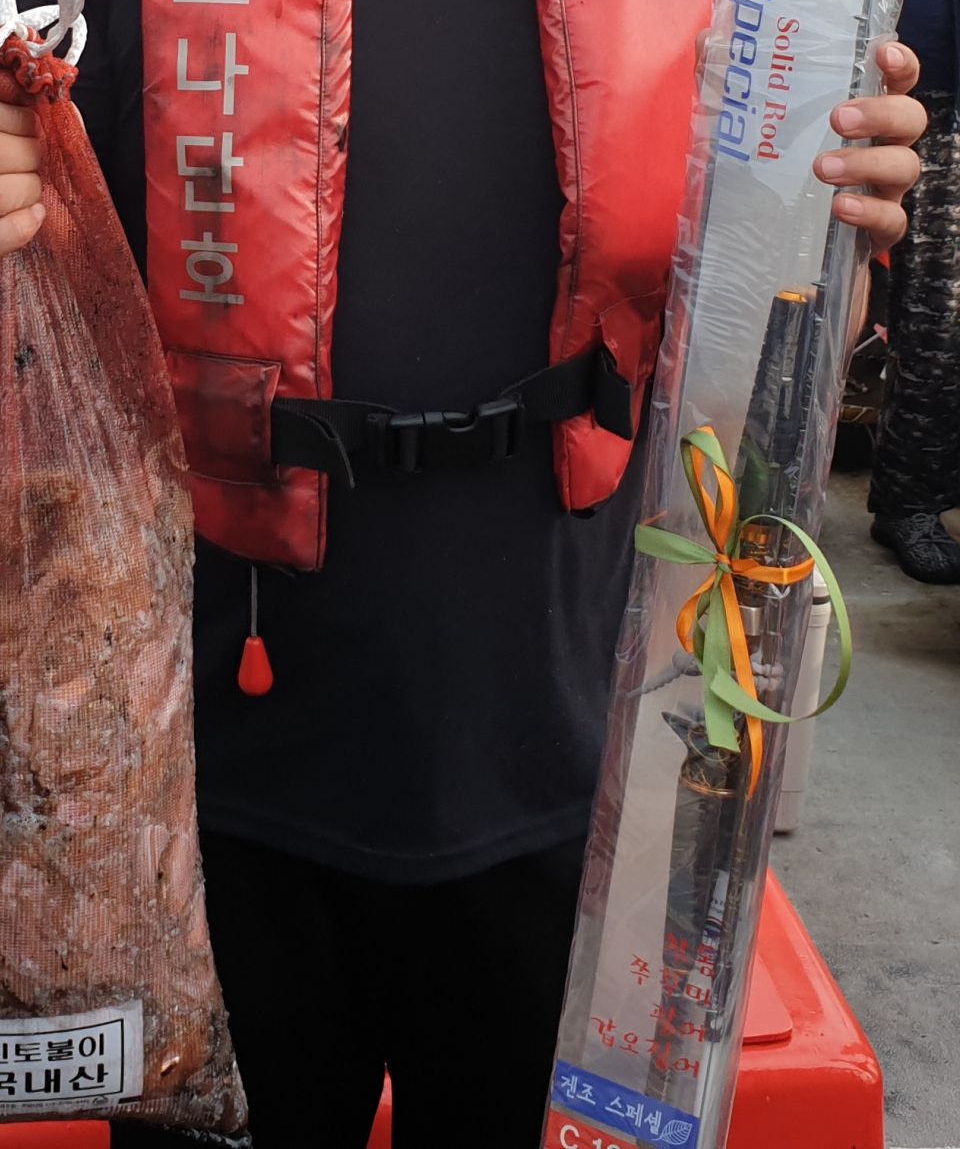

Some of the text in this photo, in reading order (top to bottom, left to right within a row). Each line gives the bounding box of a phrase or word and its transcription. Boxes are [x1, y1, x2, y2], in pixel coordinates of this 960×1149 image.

[757, 16, 800, 160] Solid Rod
[591, 1016, 700, 1079] 갑오징어
